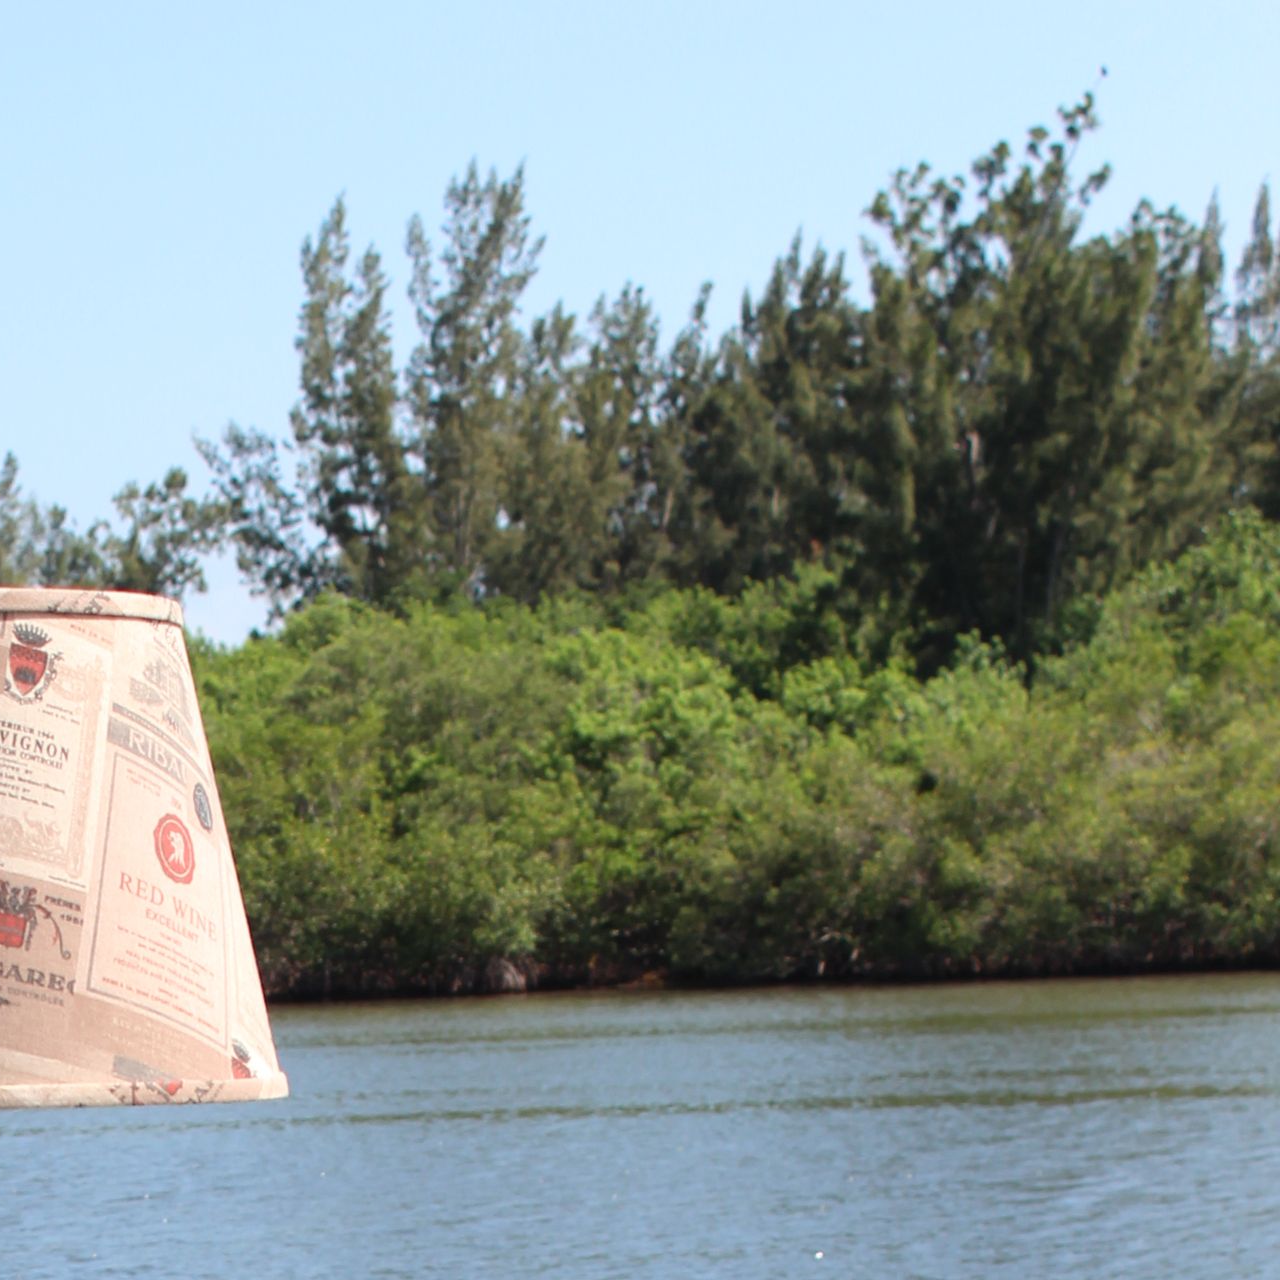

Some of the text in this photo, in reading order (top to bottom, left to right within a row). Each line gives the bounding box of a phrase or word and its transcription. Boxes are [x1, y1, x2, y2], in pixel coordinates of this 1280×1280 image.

[119, 871, 217, 941] RED WINE
[145, 908, 199, 944] EXCELLENT
